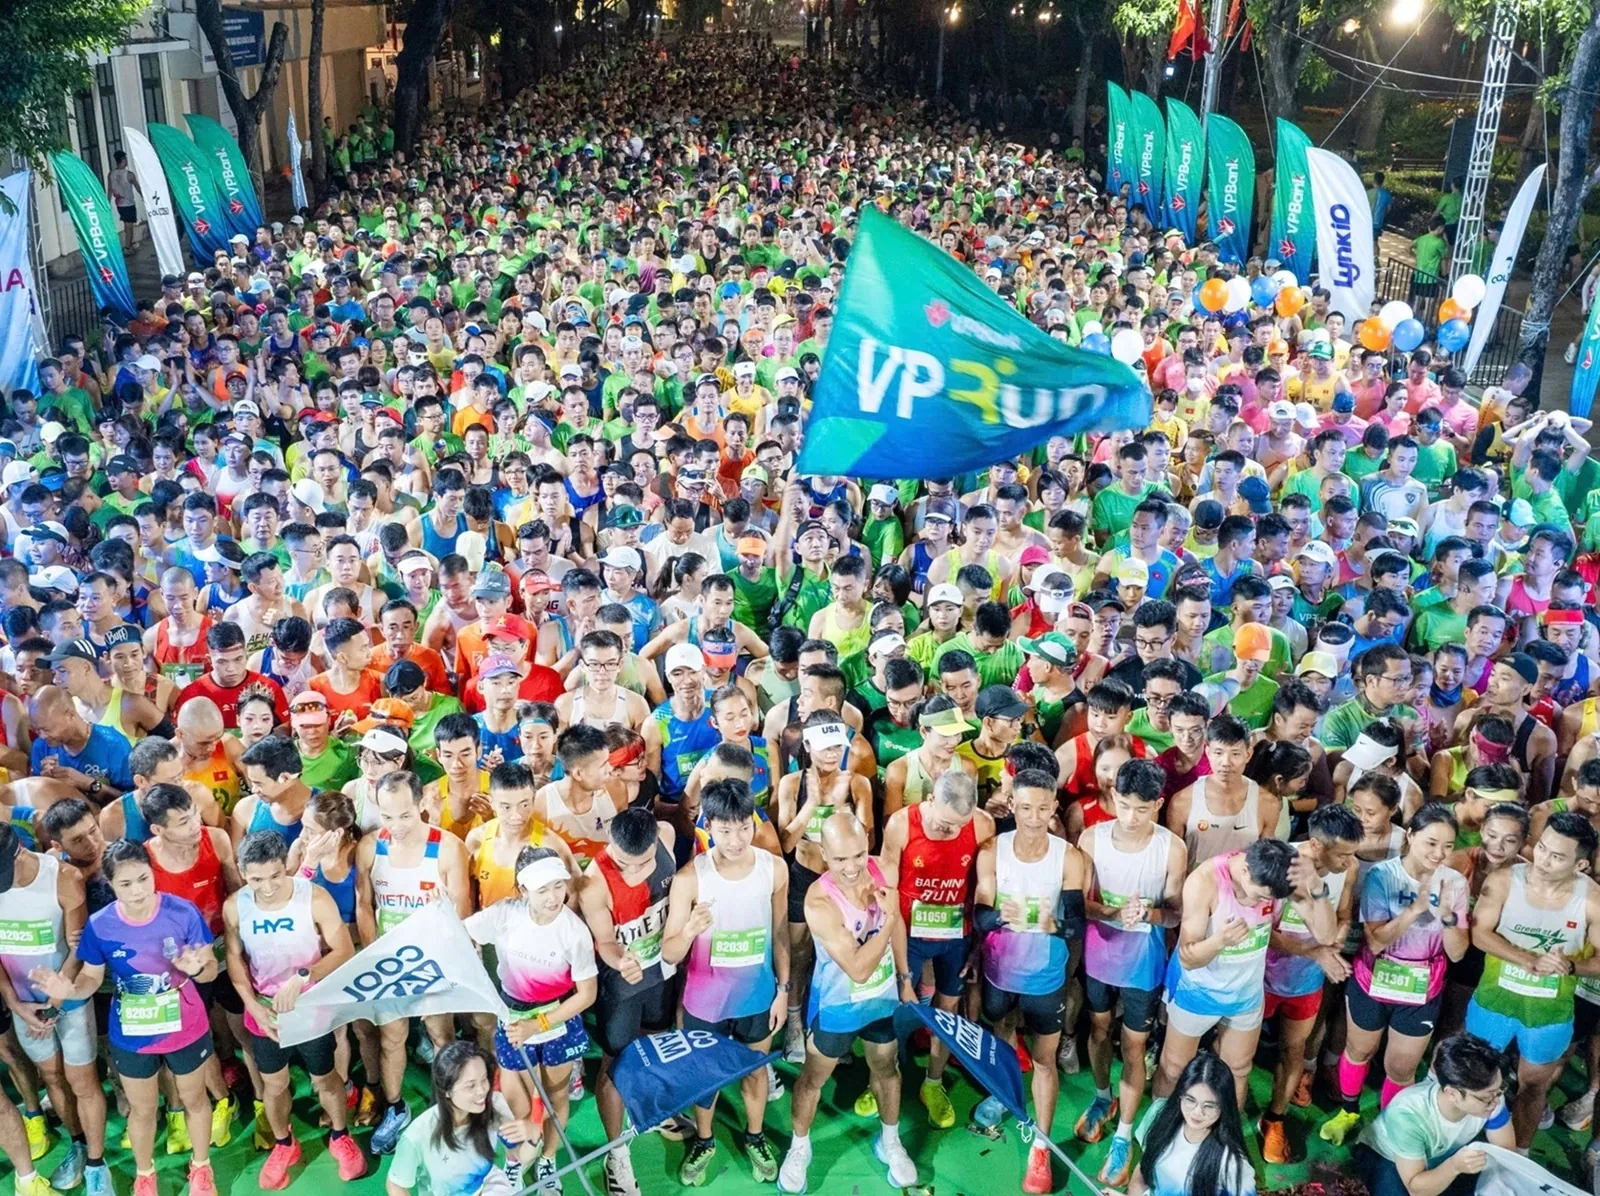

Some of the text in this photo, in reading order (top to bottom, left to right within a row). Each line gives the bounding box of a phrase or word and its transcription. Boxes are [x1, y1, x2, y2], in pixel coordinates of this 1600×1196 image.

[1141, 129, 1154, 178] VPBank
[216, 147, 240, 197] VPBank
[1176, 140, 1192, 192] VPBank
[181, 161, 206, 215] VPBank
[1223, 158, 1239, 215] VPBank
[1287, 171, 1306, 234] VPBank
[80, 195, 108, 263] VPBank
[494, 659, 513, 668] USA
[821, 725, 840, 734] USA
[920, 889, 959, 902] RUN
[915, 910, 948, 923] 81059
[252, 917, 295, 935] HYR
[716, 940, 749, 953] 82030
[1376, 970, 1411, 988] 81361
[125, 1006, 160, 1020] 82037
